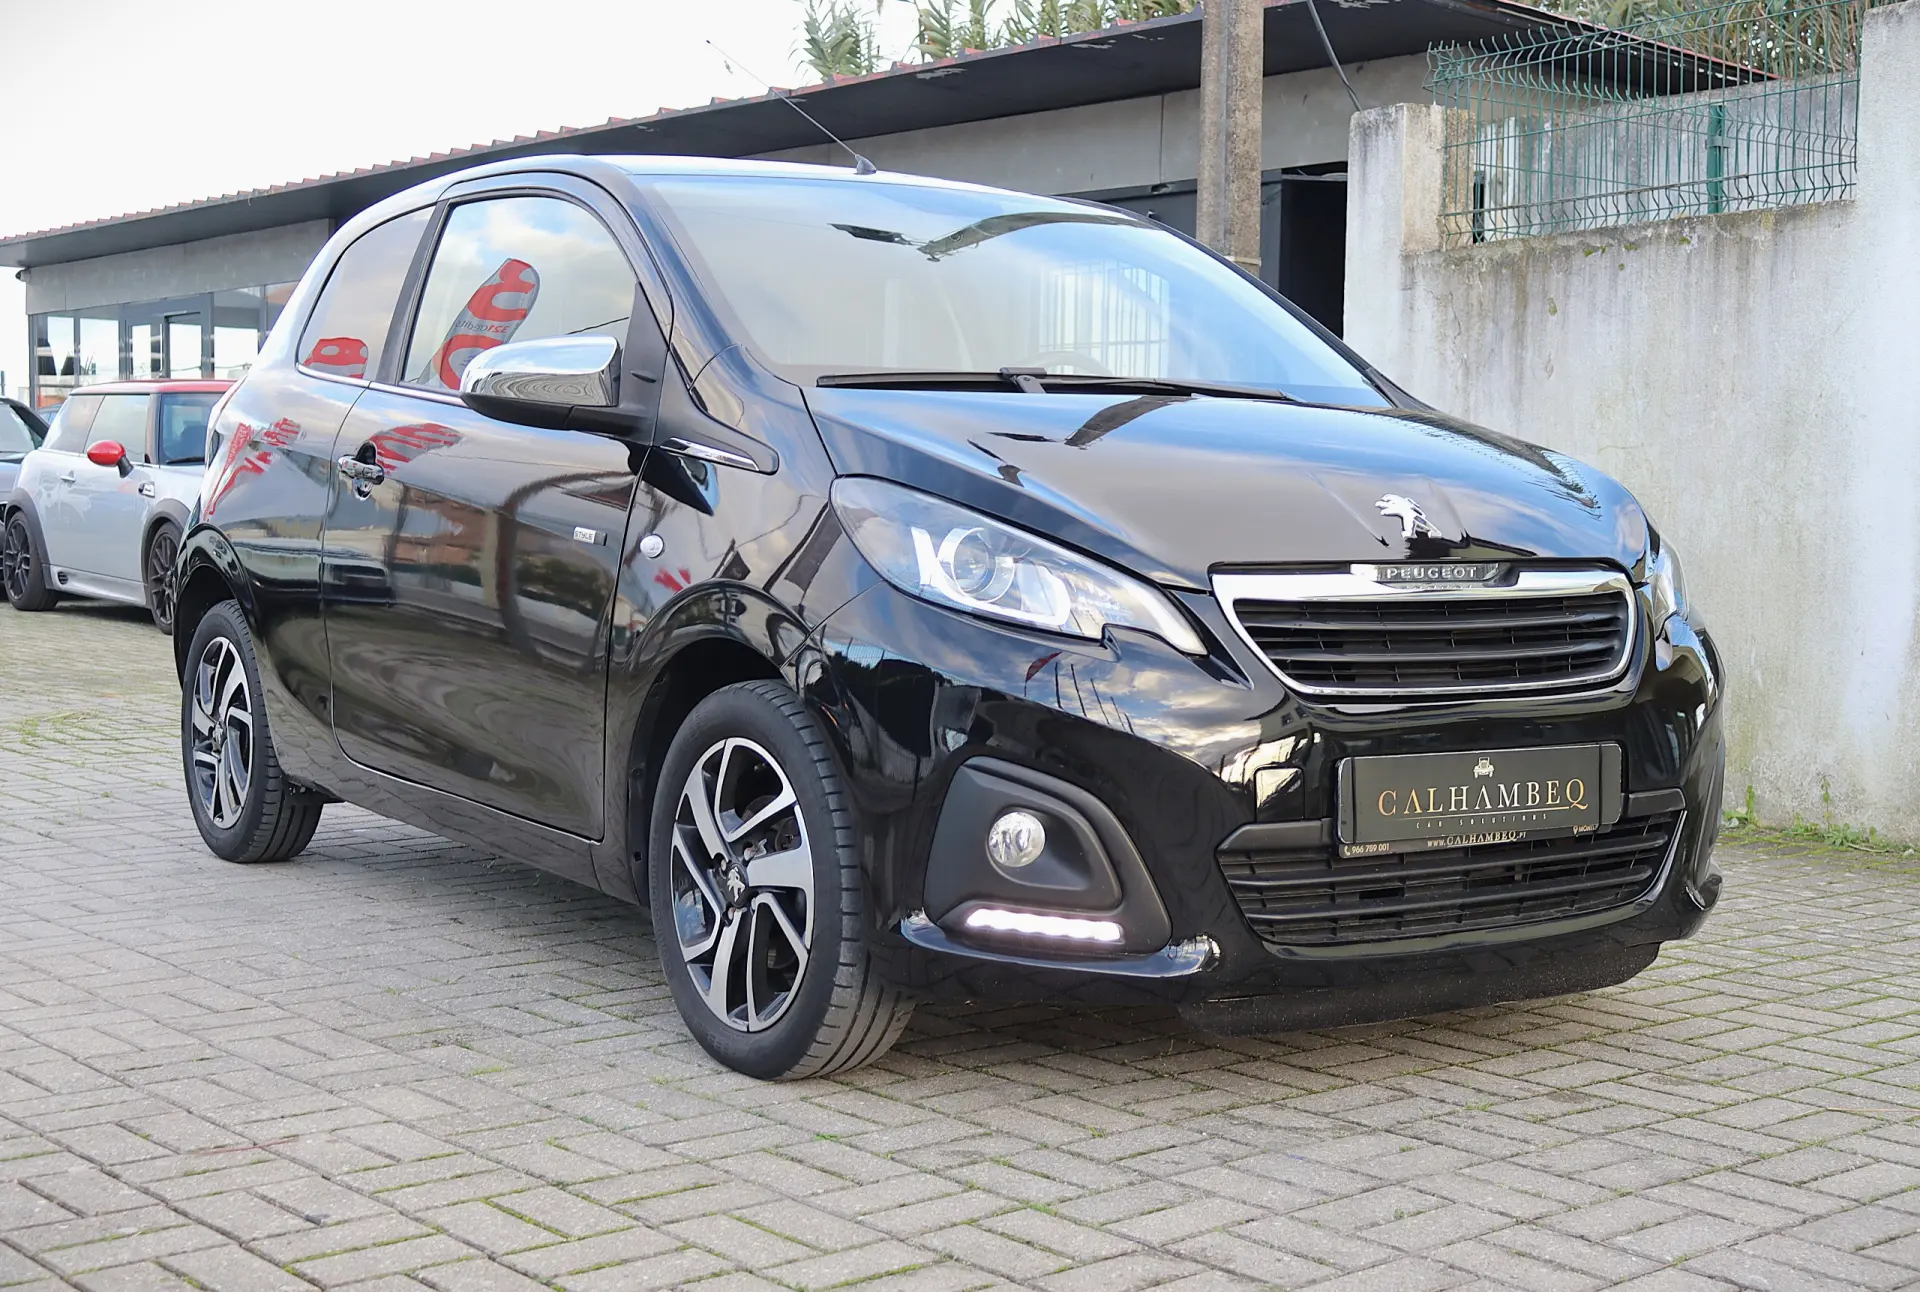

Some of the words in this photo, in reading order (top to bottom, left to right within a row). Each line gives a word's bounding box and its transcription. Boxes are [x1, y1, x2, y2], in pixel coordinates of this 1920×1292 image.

[574, 530, 594, 541] STYLE
[1386, 566, 1477, 580] PEUGEOT
[1378, 778, 1588, 816] CALHAMBEQ
[1416, 820, 1442, 829] CAR
[1460, 813, 1547, 826] SOLUTIONS
[1351, 845, 1364, 854] 966
[1378, 842, 1389, 851] 001
